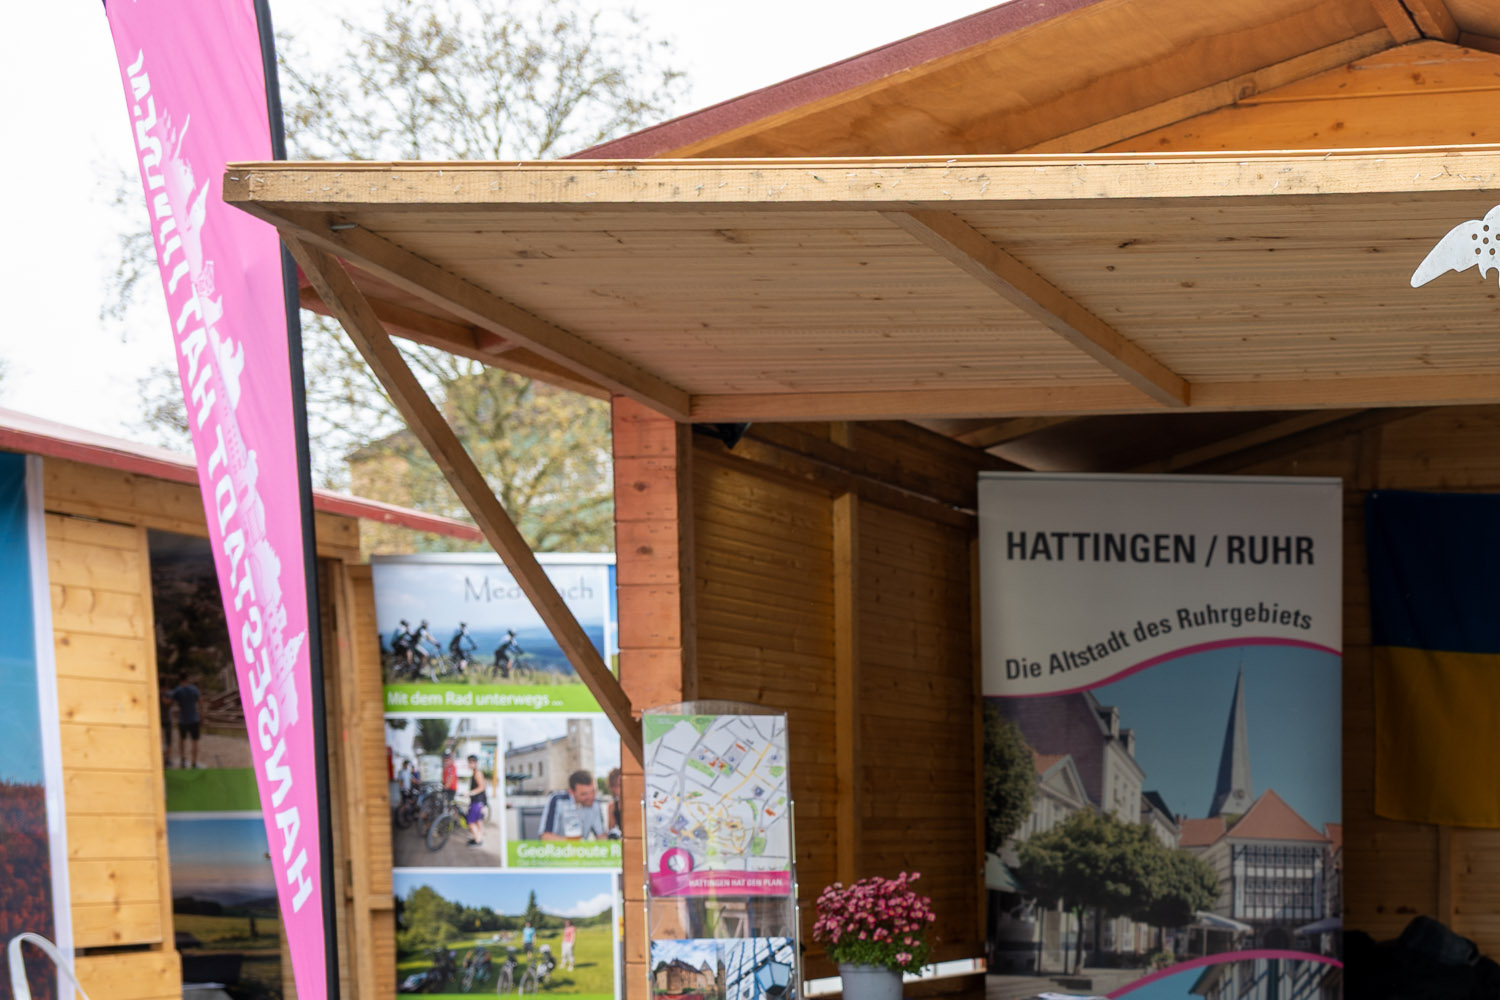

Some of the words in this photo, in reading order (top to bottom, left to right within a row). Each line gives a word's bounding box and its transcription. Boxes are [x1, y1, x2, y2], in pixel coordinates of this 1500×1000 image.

[1006, 531, 1196, 563] HATTINGEN
[1205, 535, 1218, 567] /
[1226, 535, 1315, 565] RUHR
[1006, 657, 1042, 680] Die
[1048, 632, 1131, 676] Altstadt
[1133, 618, 1172, 643] des
[1176, 602, 1313, 631] Ruhrgebiets
[387, 691, 408, 706] Mit
[410, 691, 442, 706] dem
[445, 691, 473, 706] Rad
[475, 691, 549, 709] unterwegs
